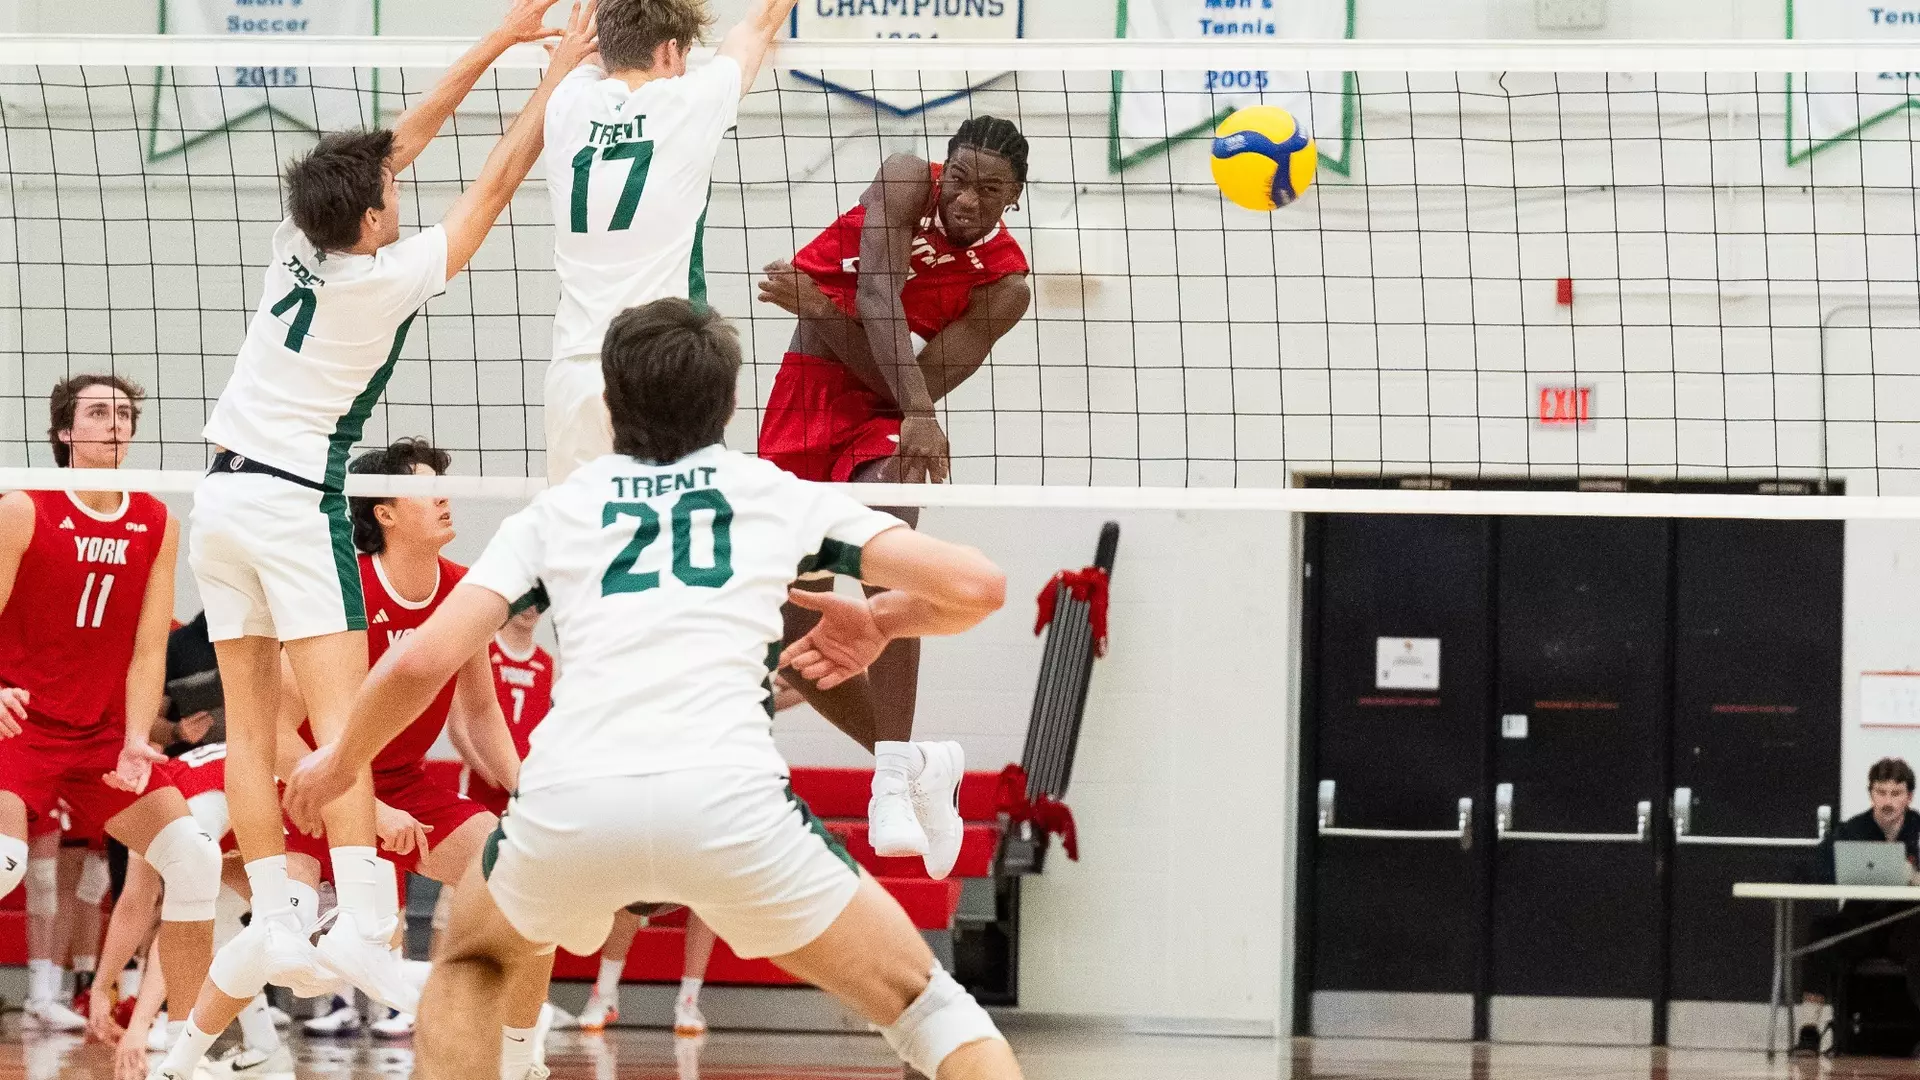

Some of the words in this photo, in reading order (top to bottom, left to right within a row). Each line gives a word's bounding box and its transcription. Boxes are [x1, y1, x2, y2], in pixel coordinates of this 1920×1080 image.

[227, 14, 309, 33] Soccer
[1199, 18, 1275, 35] Tennis
[235, 66, 298, 87] 2015
[1204, 70, 1269, 89] 2005
[588, 114, 647, 146] TRENT
[570, 139, 655, 234] 17
[270, 282, 318, 354] 4
[1540, 387, 1590, 424] EXIT
[611, 466, 717, 499] TRENT
[74, 535, 130, 566] YORK
[601, 488, 734, 598] 20
[75, 572, 116, 629] 11
